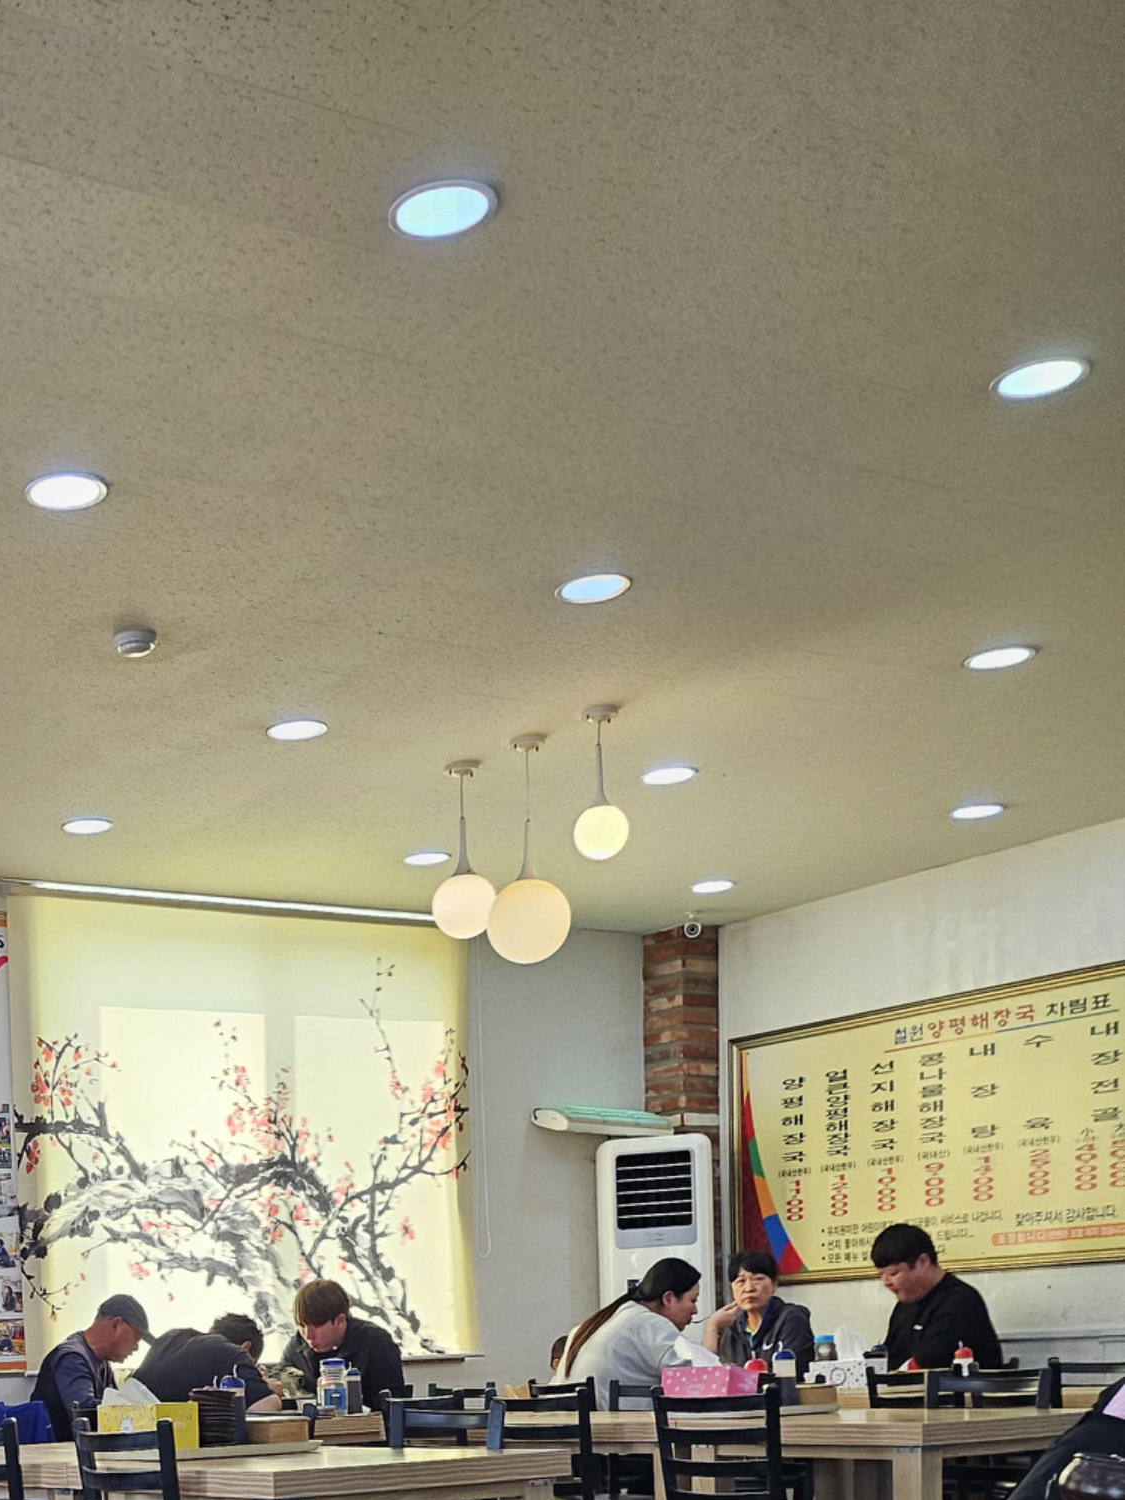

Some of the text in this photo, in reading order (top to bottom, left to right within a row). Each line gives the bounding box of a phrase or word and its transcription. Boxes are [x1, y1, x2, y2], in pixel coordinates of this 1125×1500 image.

[894, 993, 1111, 1045] 철원 양평해장국 차림표
[871, 1060, 898, 1150] 선지해장국
[969, 1043, 999, 1139] 내장탕
[1089, 1021, 1124, 1123] 내장전골
[781, 1076, 806, 1163] 양평해장국
